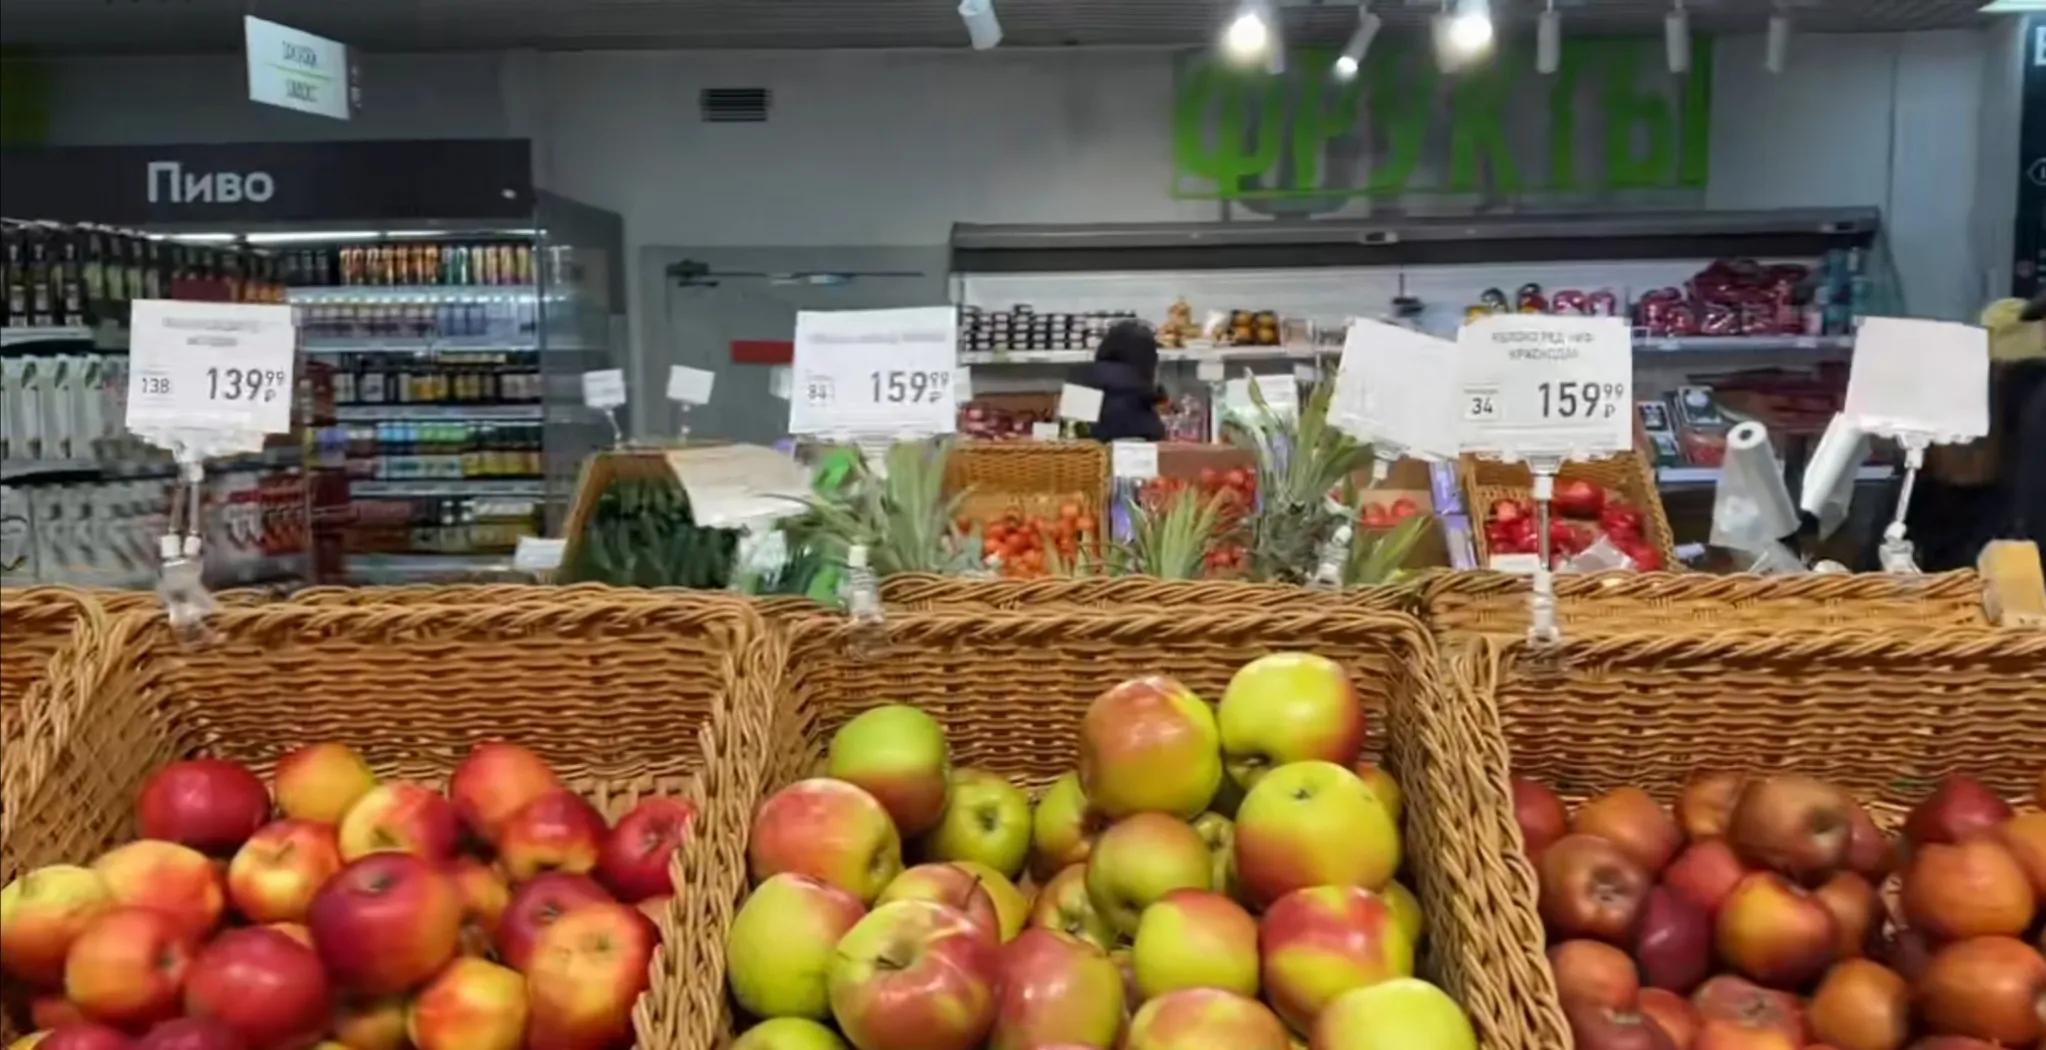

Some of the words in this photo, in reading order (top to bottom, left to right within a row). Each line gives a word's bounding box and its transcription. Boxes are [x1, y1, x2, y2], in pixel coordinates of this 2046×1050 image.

[1174, 38, 1710, 198] ФРУКТЫ
[147, 161, 275, 205] Пиво
[141, 377, 170, 394] 138
[206, 367, 263, 401] 139
[264, 370, 286, 386] 99
[870, 370, 928, 404] 159
[1538, 381, 1601, 418] 159
[1603, 383, 1625, 398] 99
[1471, 397, 1494, 415] 34
